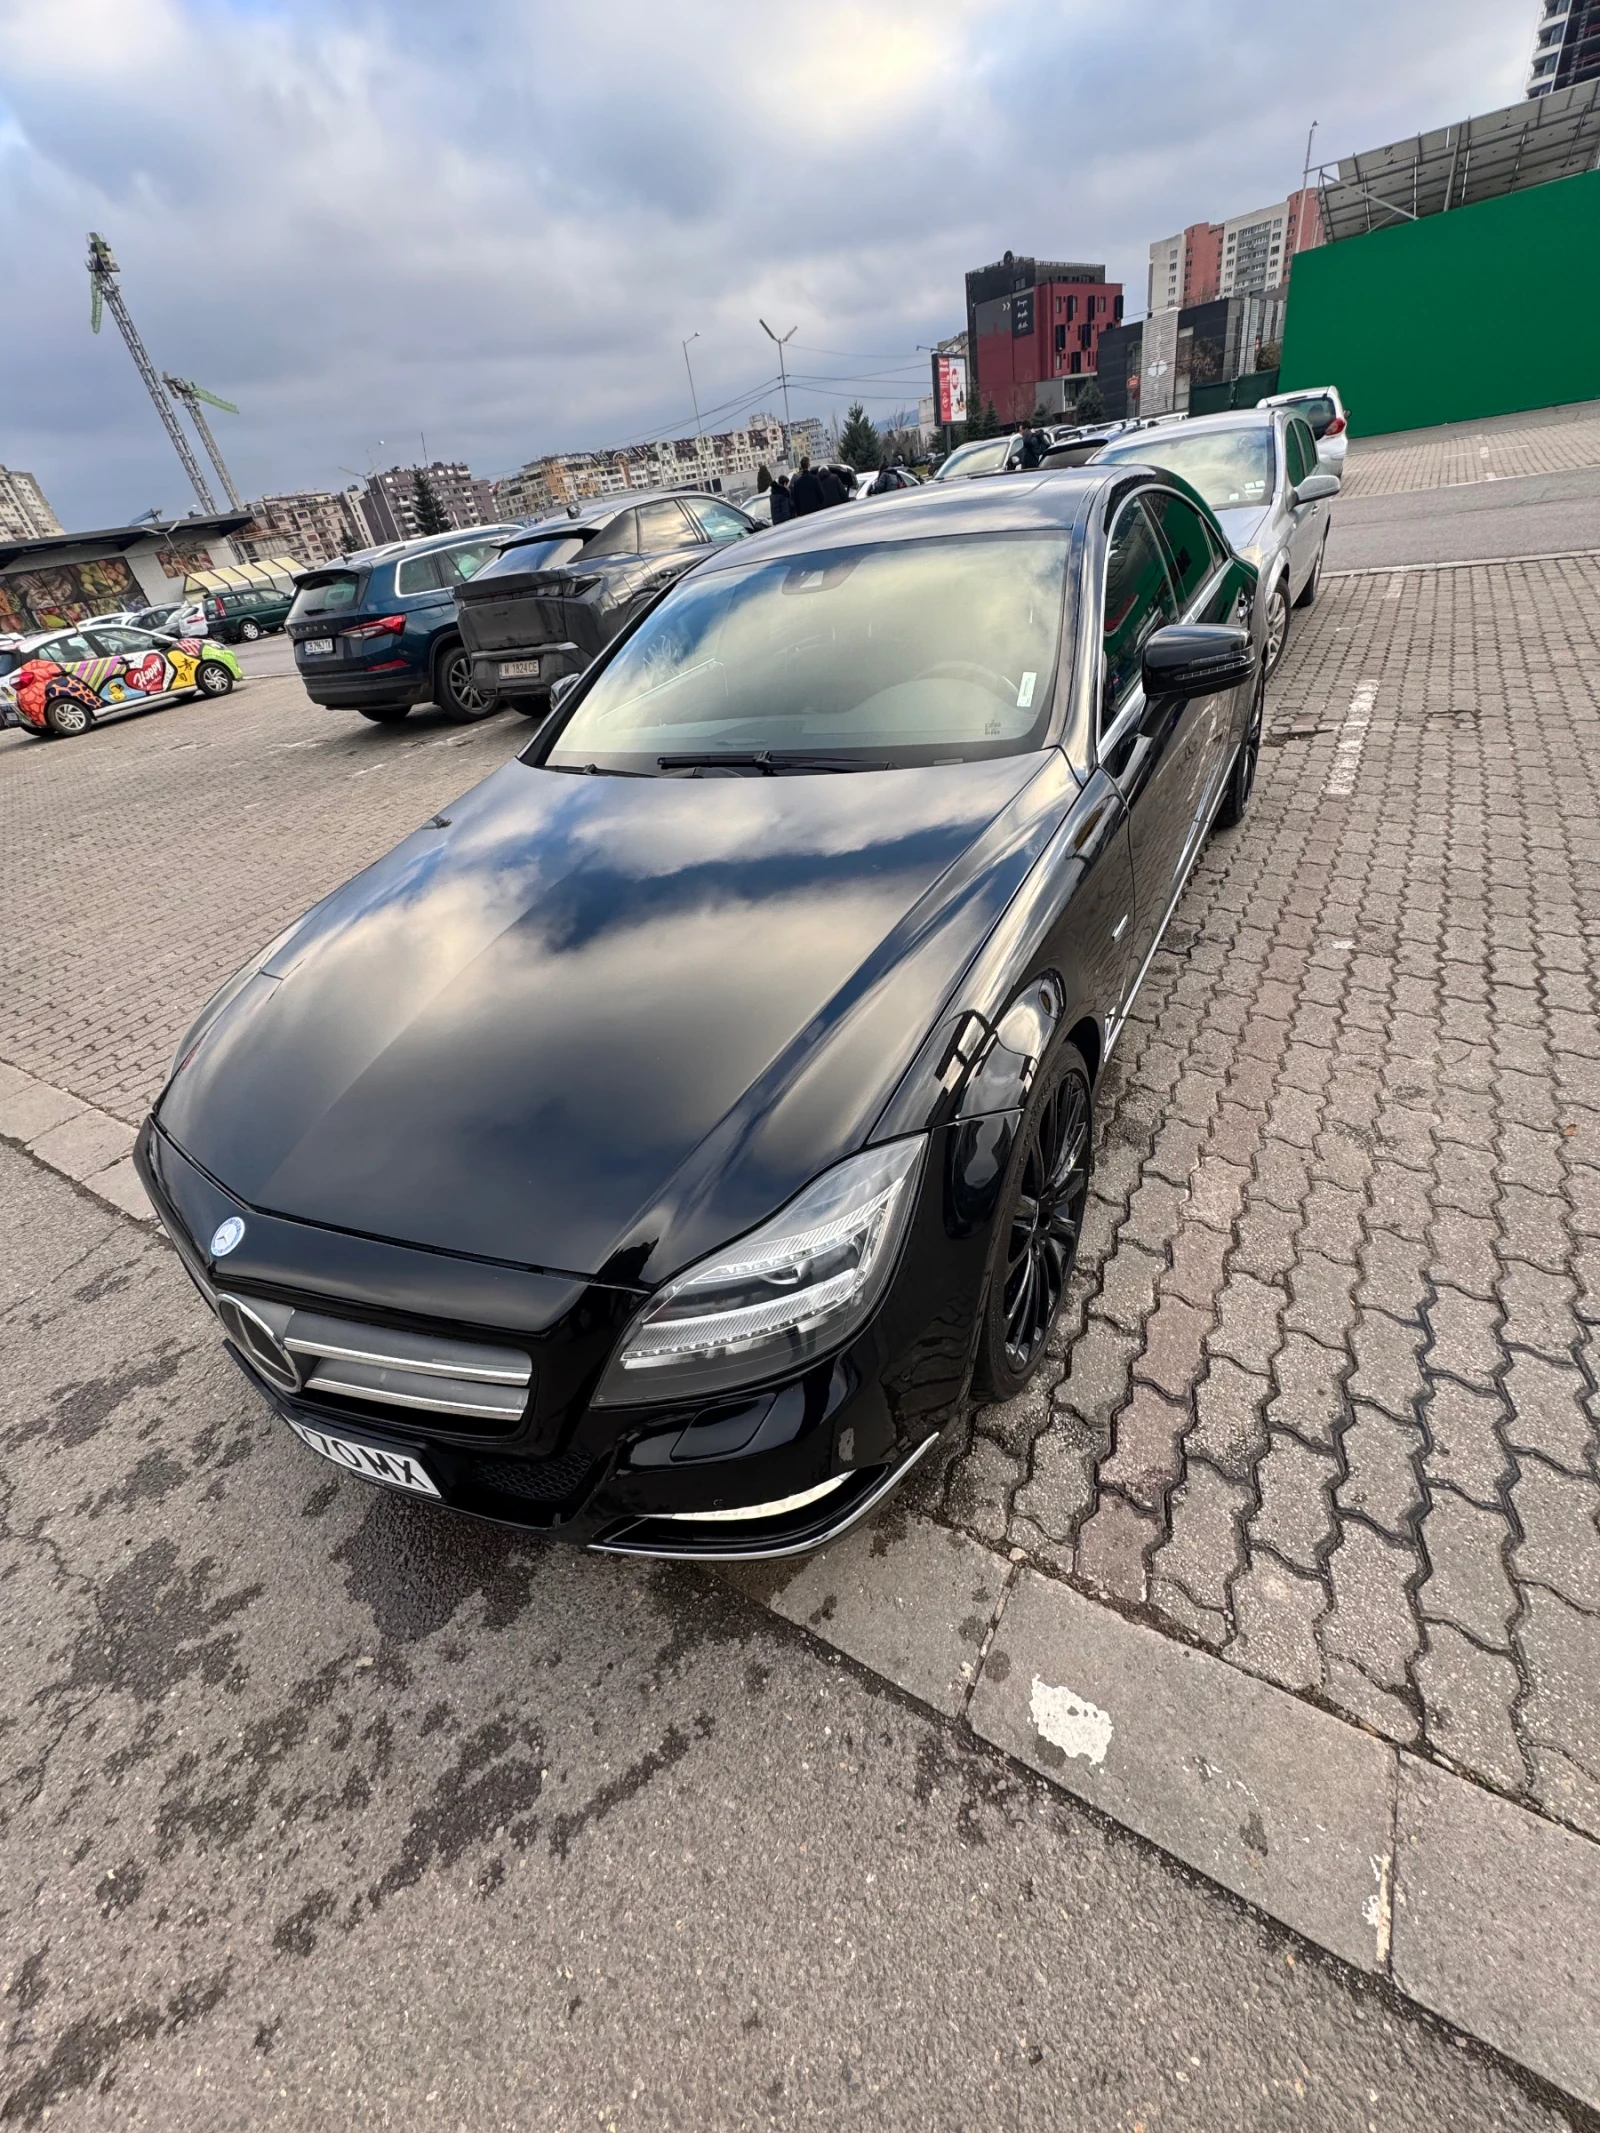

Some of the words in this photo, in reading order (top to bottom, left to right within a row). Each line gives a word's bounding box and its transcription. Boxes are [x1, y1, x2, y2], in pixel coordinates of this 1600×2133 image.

[133, 658, 162, 689] Happy
[512, 661, 528, 674] 1824
[356, 1446, 429, 1489] MX
